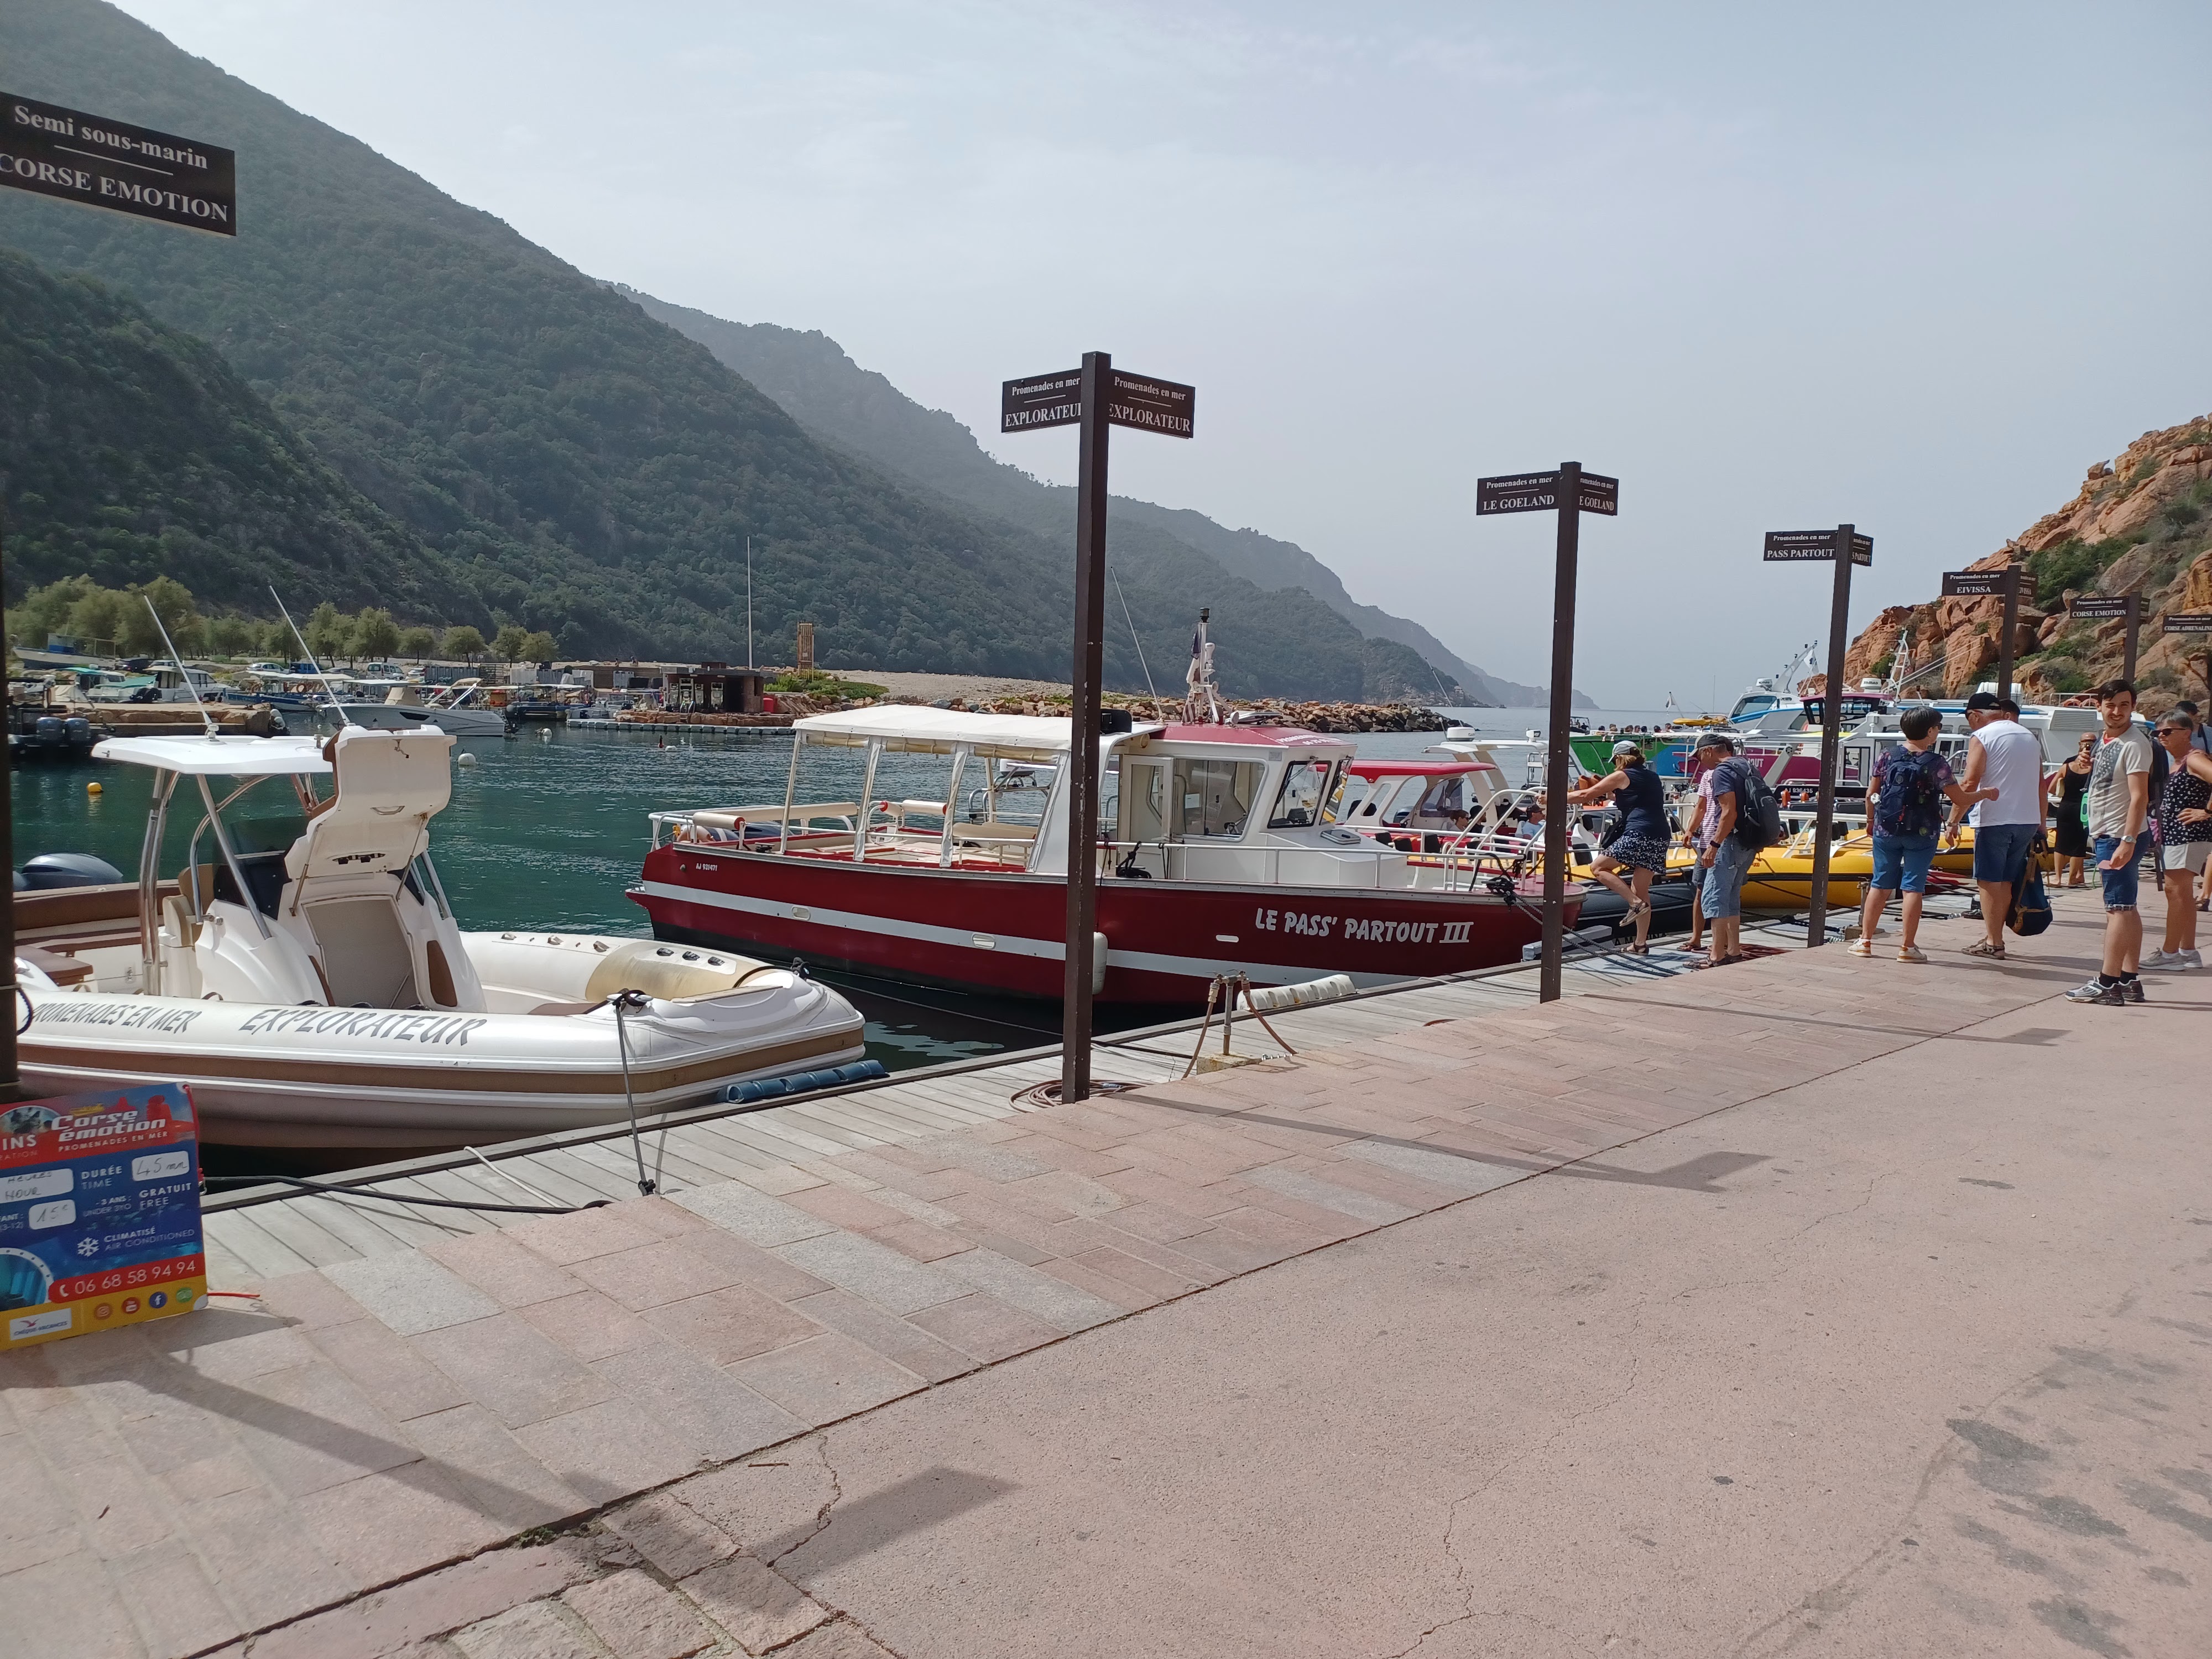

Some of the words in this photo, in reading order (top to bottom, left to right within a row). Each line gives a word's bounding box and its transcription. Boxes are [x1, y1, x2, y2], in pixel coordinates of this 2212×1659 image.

[14, 105, 75, 136] Semi
[81, 126, 208, 169] sous-marin
[0, 153, 91, 191] CORSE
[99, 175, 228, 222] EMOTION
[1011, 383, 1054, 396] Promenades
[1065, 377, 1081, 387] mer
[1114, 376, 1160, 395] Promenades
[1171, 392, 1186, 400] mer
[1486, 479, 1527, 489] Promenades
[1483, 500, 1497, 511] LE
[1500, 494, 1554, 509] GOELAND
[1584, 497, 1614, 511] GOELAND
[1767, 550, 1788, 558] PASS
[1790, 549, 1834, 558] PARTOUT
[1255, 907, 1277, 930] LE
[1344, 918, 1438, 943] PARTOUT
[1439, 921, 1474, 943] III
[121, 1006, 154, 1028] EN
[147, 1009, 202, 1034] MER
[238, 1008, 488, 1046] EXPLORATEUR
[51, 1110, 138, 1130] Corse
[58, 1118, 166, 1142] émotion
[58, 1136, 128, 1152] PROMENADES
[149, 1131, 168, 1140] MER
[81, 1165, 123, 1180] DURÉE
[136, 1157, 162, 1176] 45
[81, 1178, 112, 1190] TIME
[139, 1182, 192, 1198] GRATUIT
[139, 1196, 169, 1211] FREE
[104, 1225, 155, 1243] CLIMATISÉ
[126, 1229, 195, 1247] CONDITIONED
[75, 1279, 96, 1294] 06
[101, 1274, 122, 1289] 68
[127, 1269, 147, 1284] 58
[152, 1265, 171, 1279] 94
[176, 1260, 196, 1274] 94
